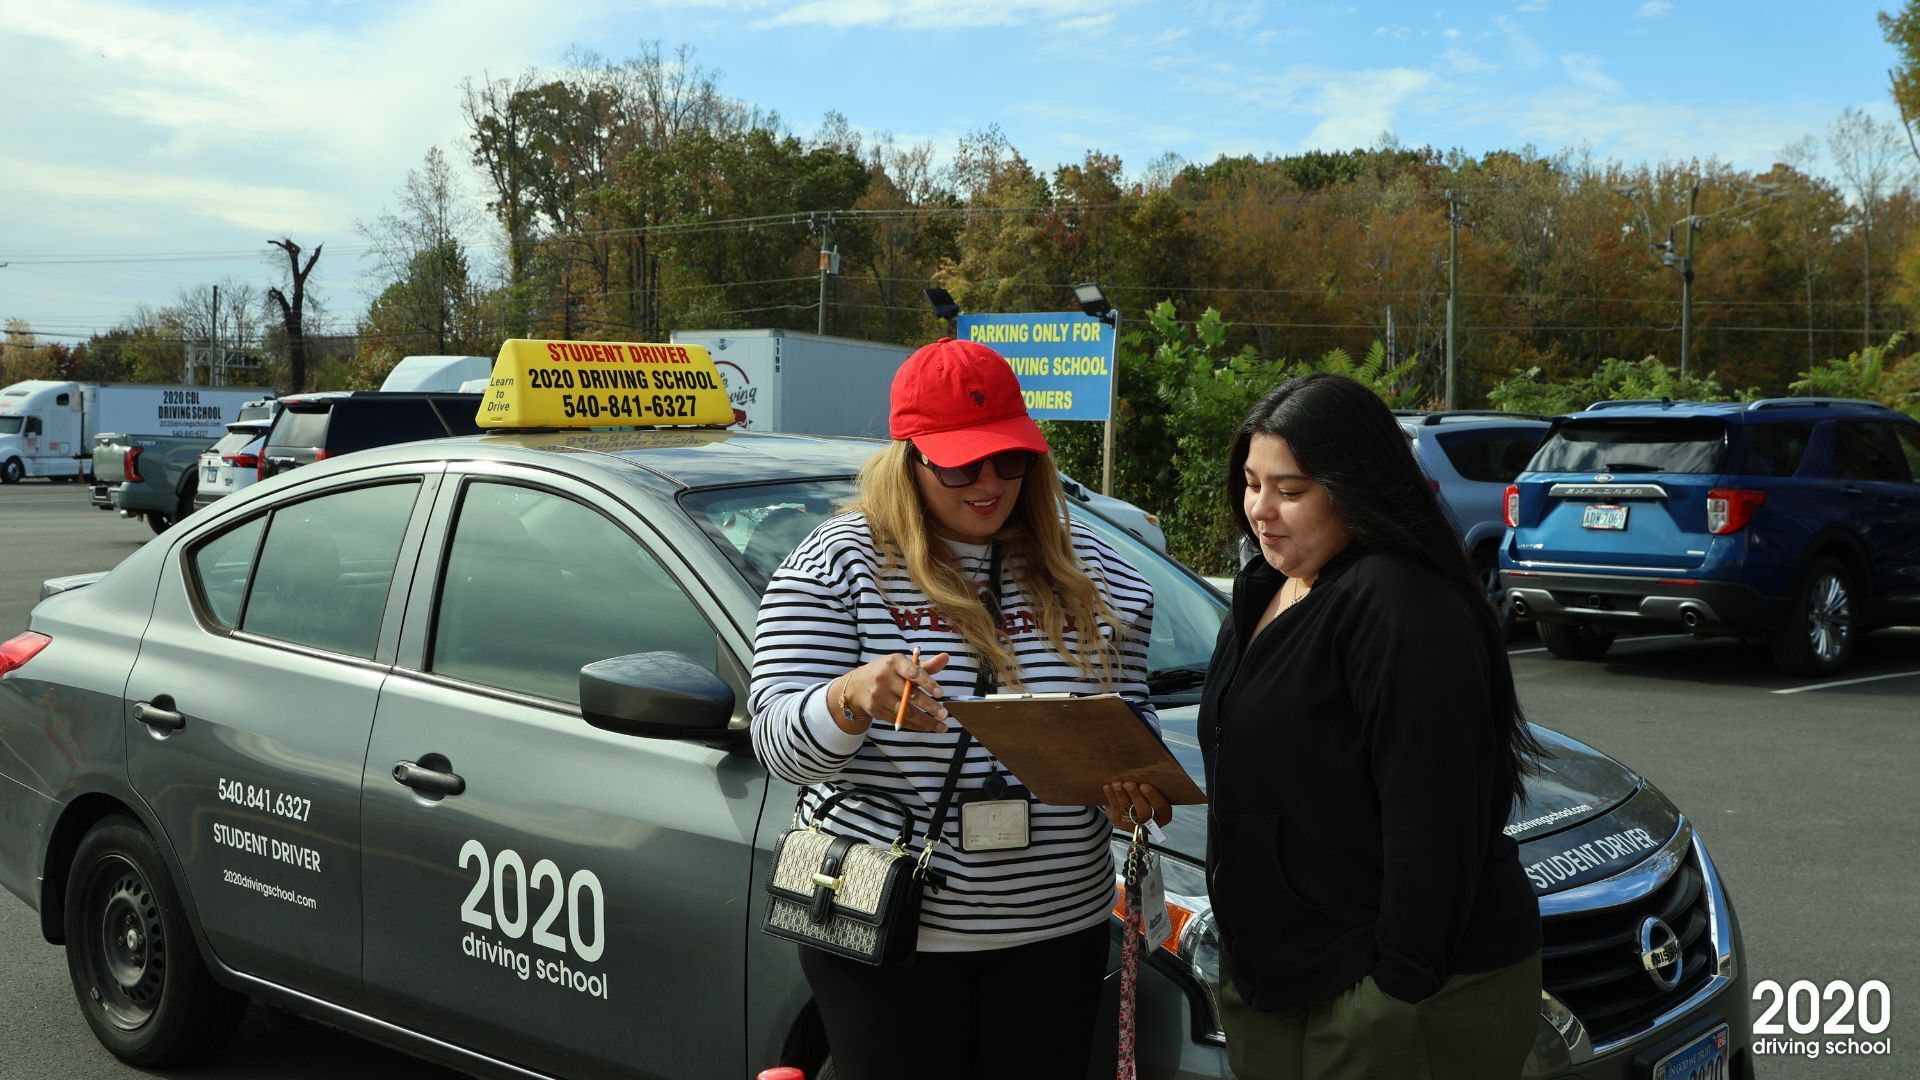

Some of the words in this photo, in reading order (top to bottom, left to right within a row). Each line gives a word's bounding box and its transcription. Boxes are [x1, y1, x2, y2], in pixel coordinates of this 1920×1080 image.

[970, 324, 1029, 343] PARKING
[1032, 323, 1069, 343] ONLY
[1073, 323, 1101, 342] FOR
[547, 343, 625, 363] STUDENT
[628, 345, 691, 364] DRIVER
[1004, 357, 1049, 376] IVING
[1053, 357, 1108, 376] SCHOOL
[490, 377, 514, 387] Learn
[528, 368, 574, 389] 2020
[578, 369, 649, 389] DRIVING
[652, 370, 718, 390] SCHOOL
[163, 390, 184, 405] 2020
[186, 391, 200, 405] CDL
[496, 390, 505, 399] to
[158, 406, 191, 419] DRIVING
[192, 406, 222, 419] SCHOOL
[487, 402, 510, 412] Drive
[563, 395, 697, 418] 540-841-6327
[218, 777, 311, 822] 540.841.6327
[1502, 804, 1593, 836] 020drivingschool.com
[213, 822, 268, 857] STUDENT
[271, 838, 322, 873] DRIVER
[1524, 843, 1601, 889] STUDENT
[1594, 827, 1659, 860] DRIVER
[223, 869, 317, 910] 2020drivingschool.com
[458, 839, 605, 963] 2020
[461, 931, 531, 981] driving
[535, 959, 608, 1000] school
